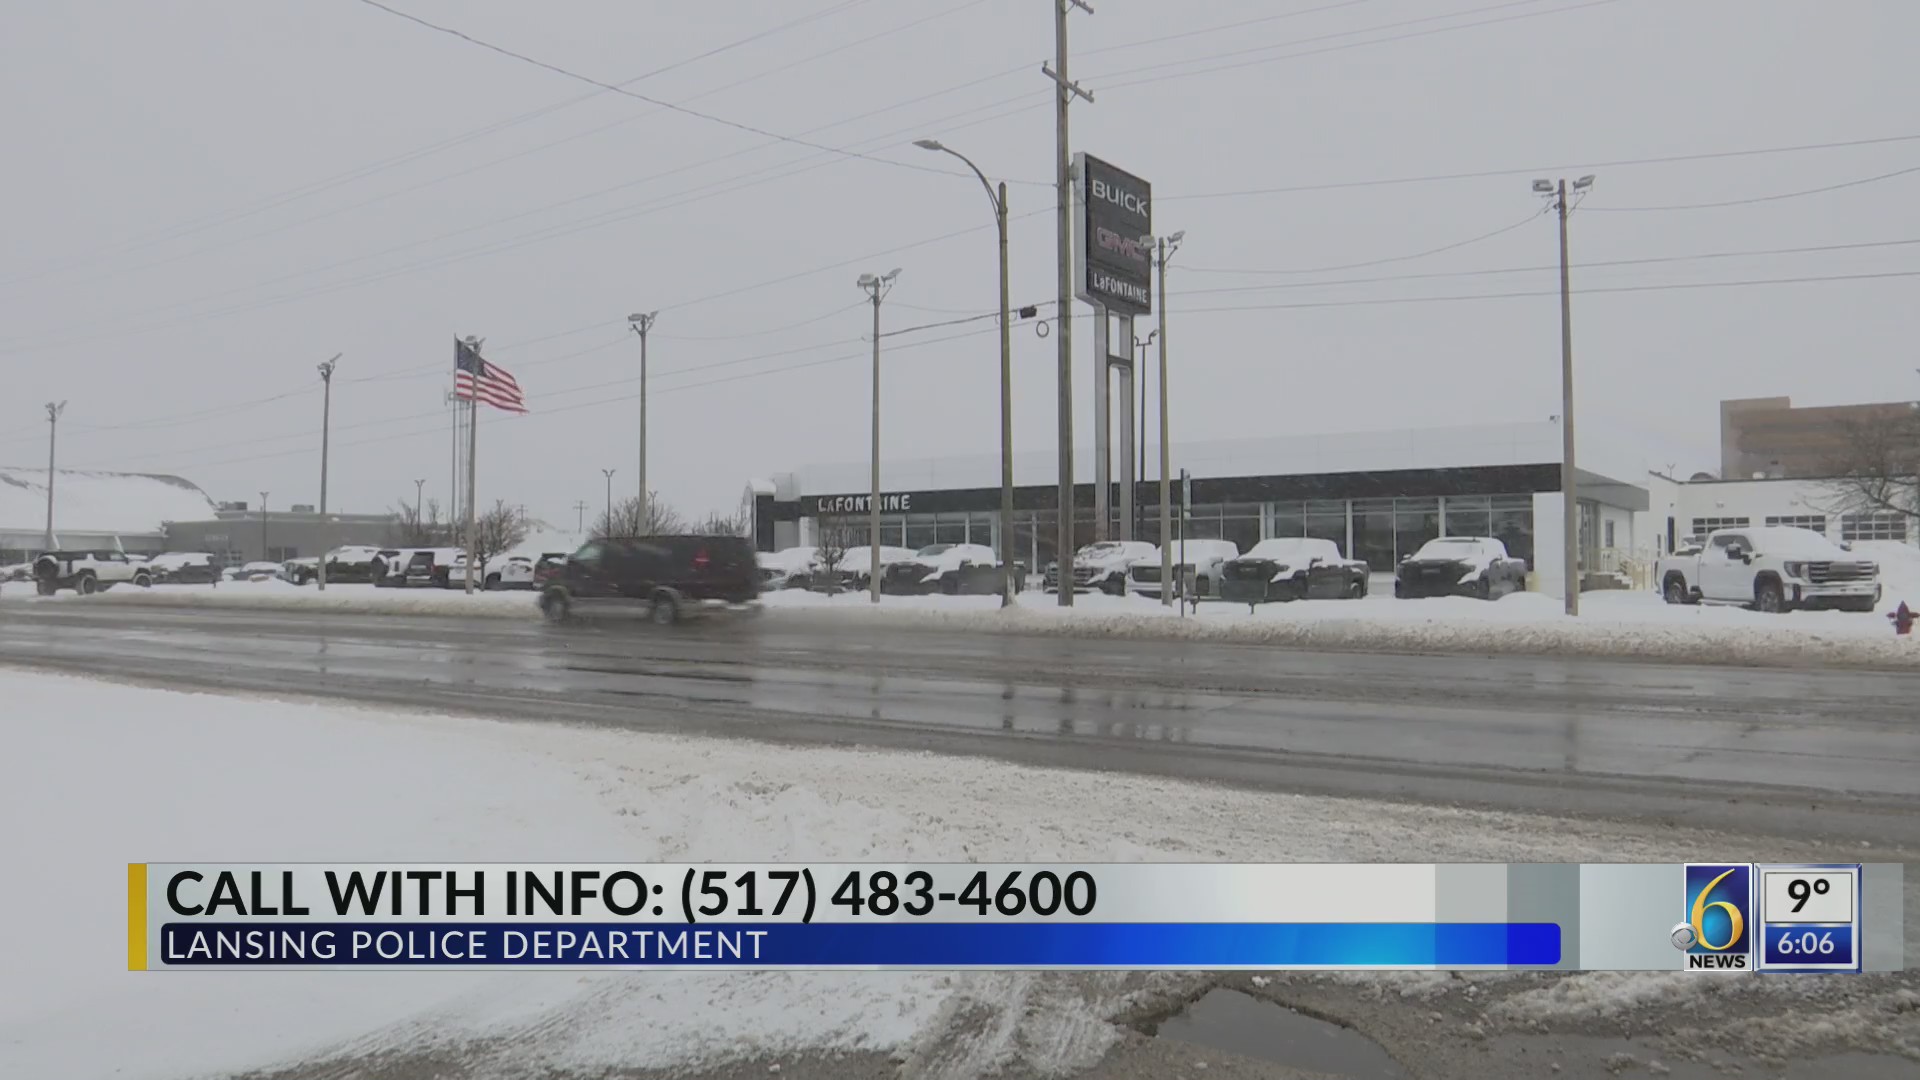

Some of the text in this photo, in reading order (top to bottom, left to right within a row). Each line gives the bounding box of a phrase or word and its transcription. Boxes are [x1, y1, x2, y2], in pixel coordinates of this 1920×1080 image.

[1092, 180, 1148, 217] BUICK
[1097, 227, 1146, 261] GMC
[1094, 273, 1147, 303] LaFONTAINE
[818, 495, 910, 512] LAFONTINE
